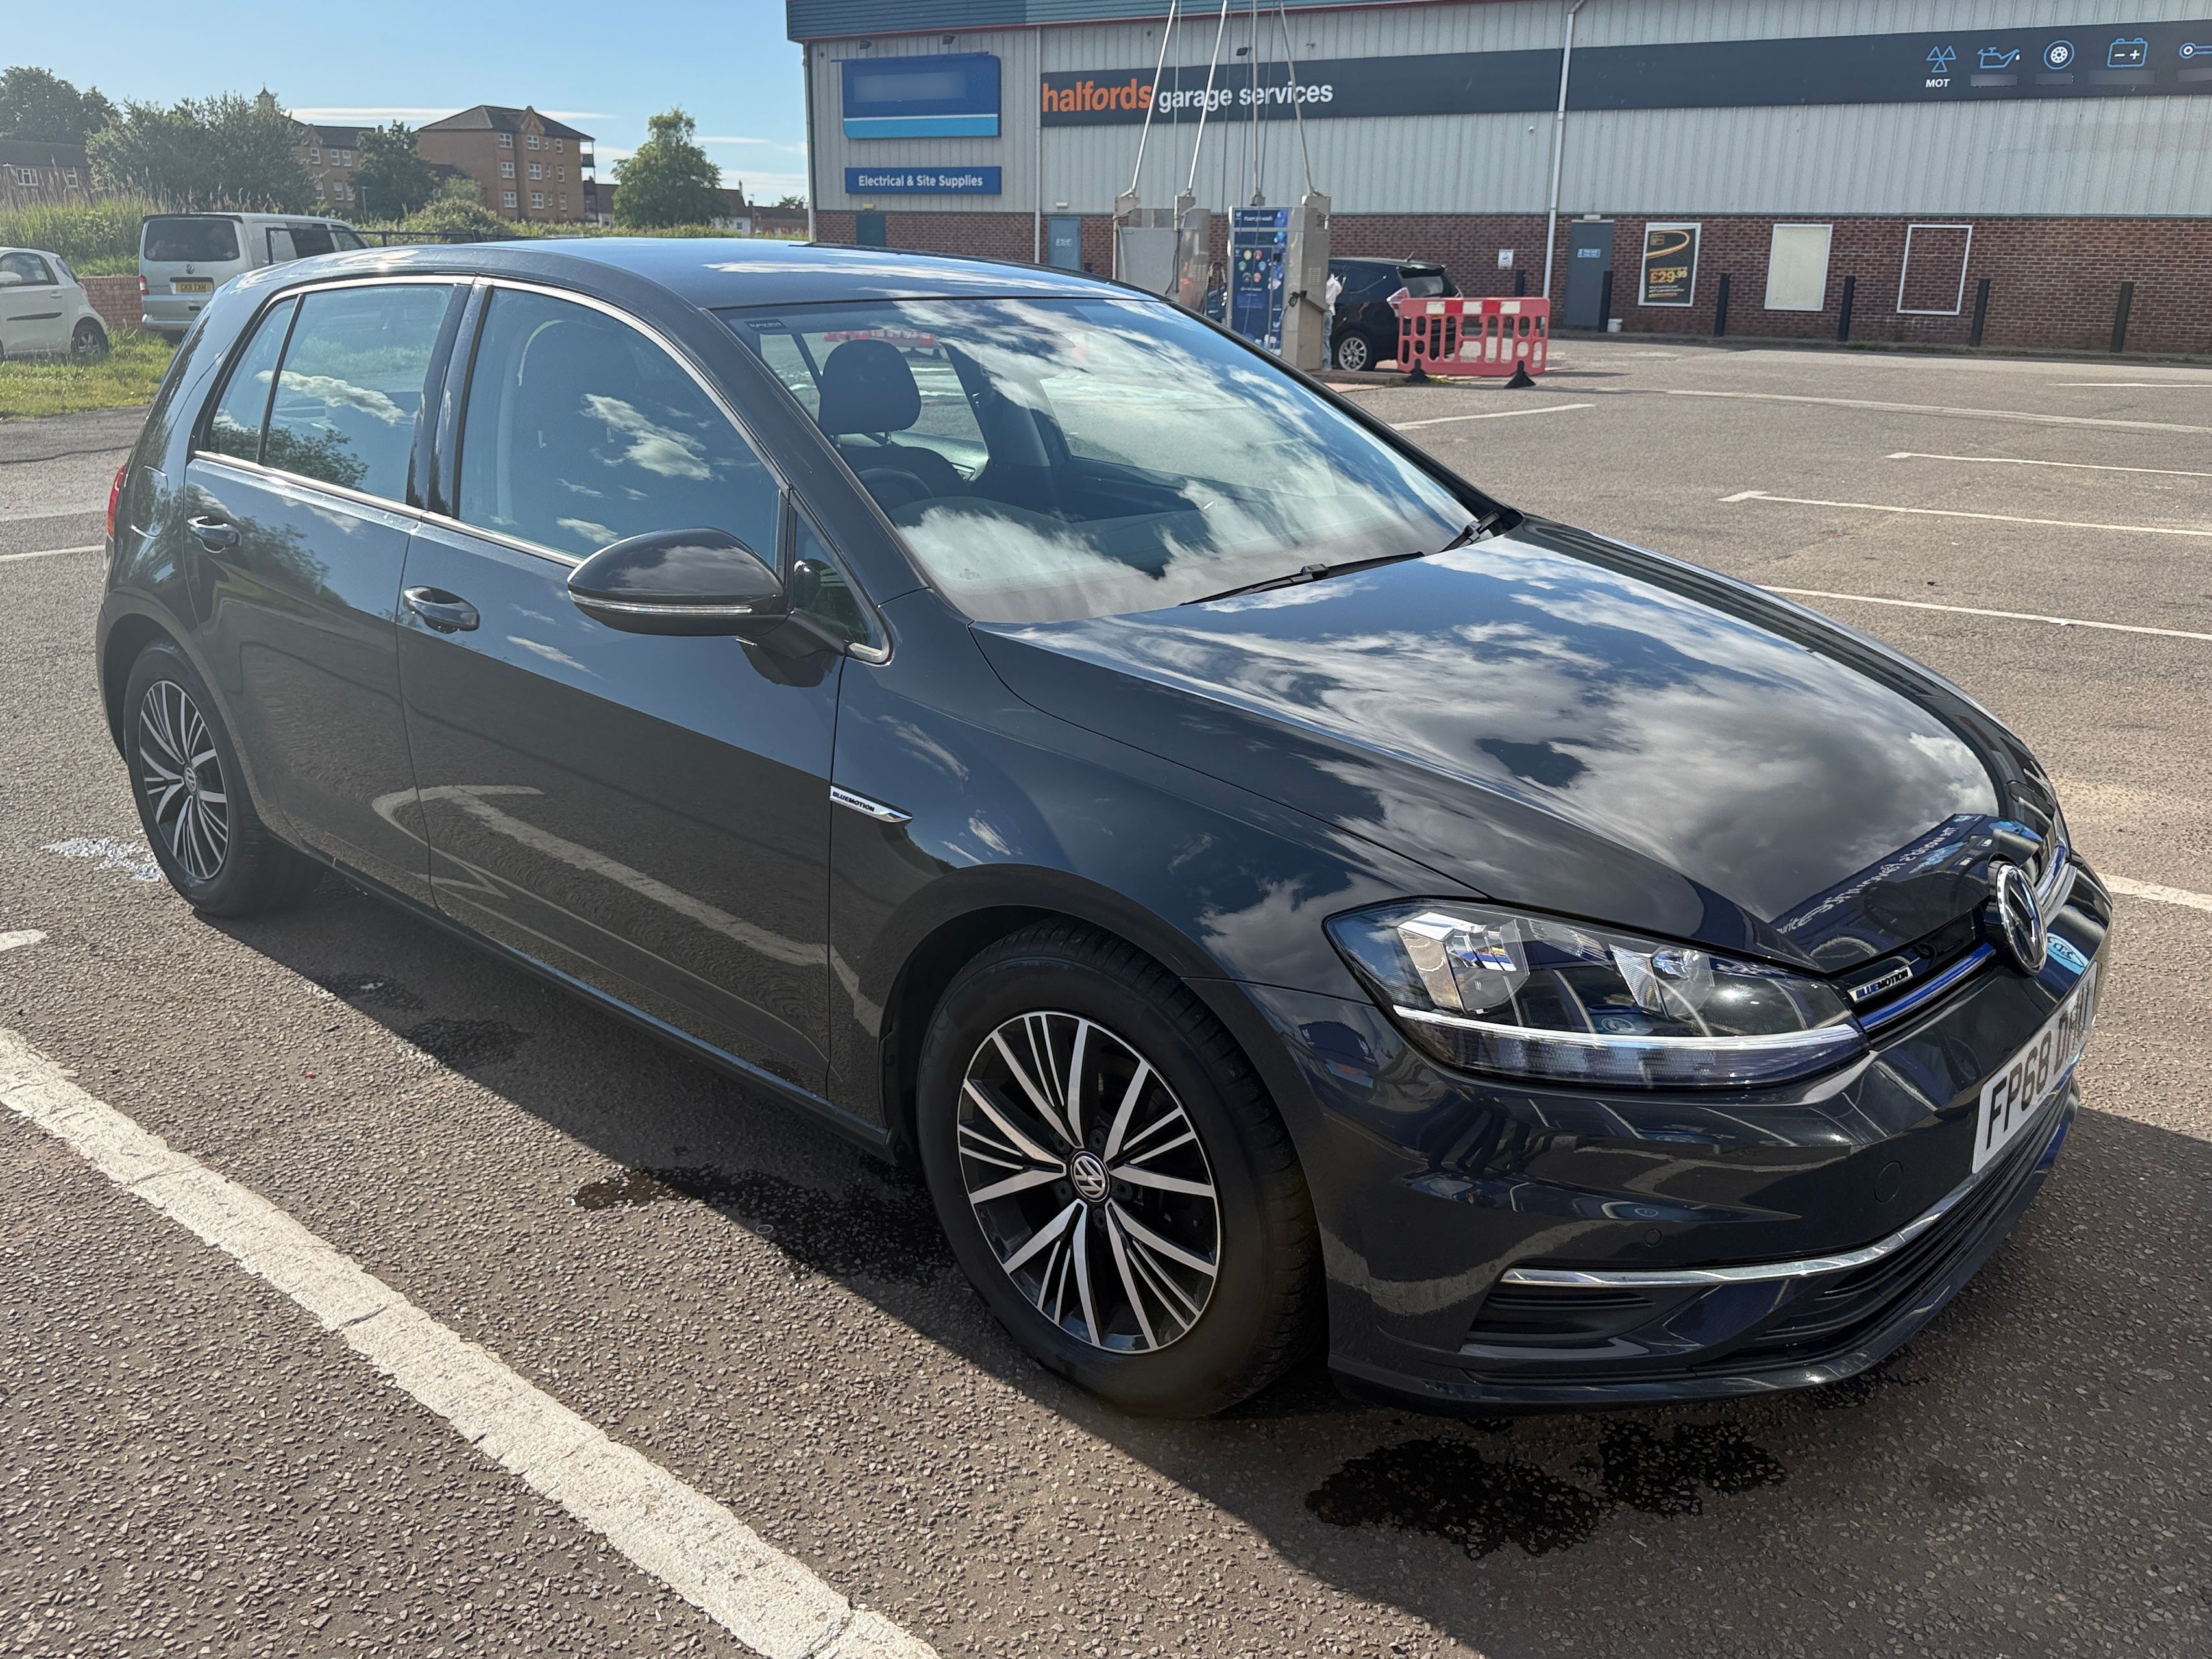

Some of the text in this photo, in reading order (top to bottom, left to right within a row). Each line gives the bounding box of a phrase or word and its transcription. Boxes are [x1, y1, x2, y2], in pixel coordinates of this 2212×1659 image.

[1042, 79, 1333, 113] halfords garage services
[1926, 79, 1950, 88] MOT
[859, 174, 983, 188] Electrical & Site Supplies
[833, 791, 875, 813] BLUEMOTION
[1856, 969, 1908, 999] BLUEMOTION
[1986, 1031, 2052, 1151] FP68
